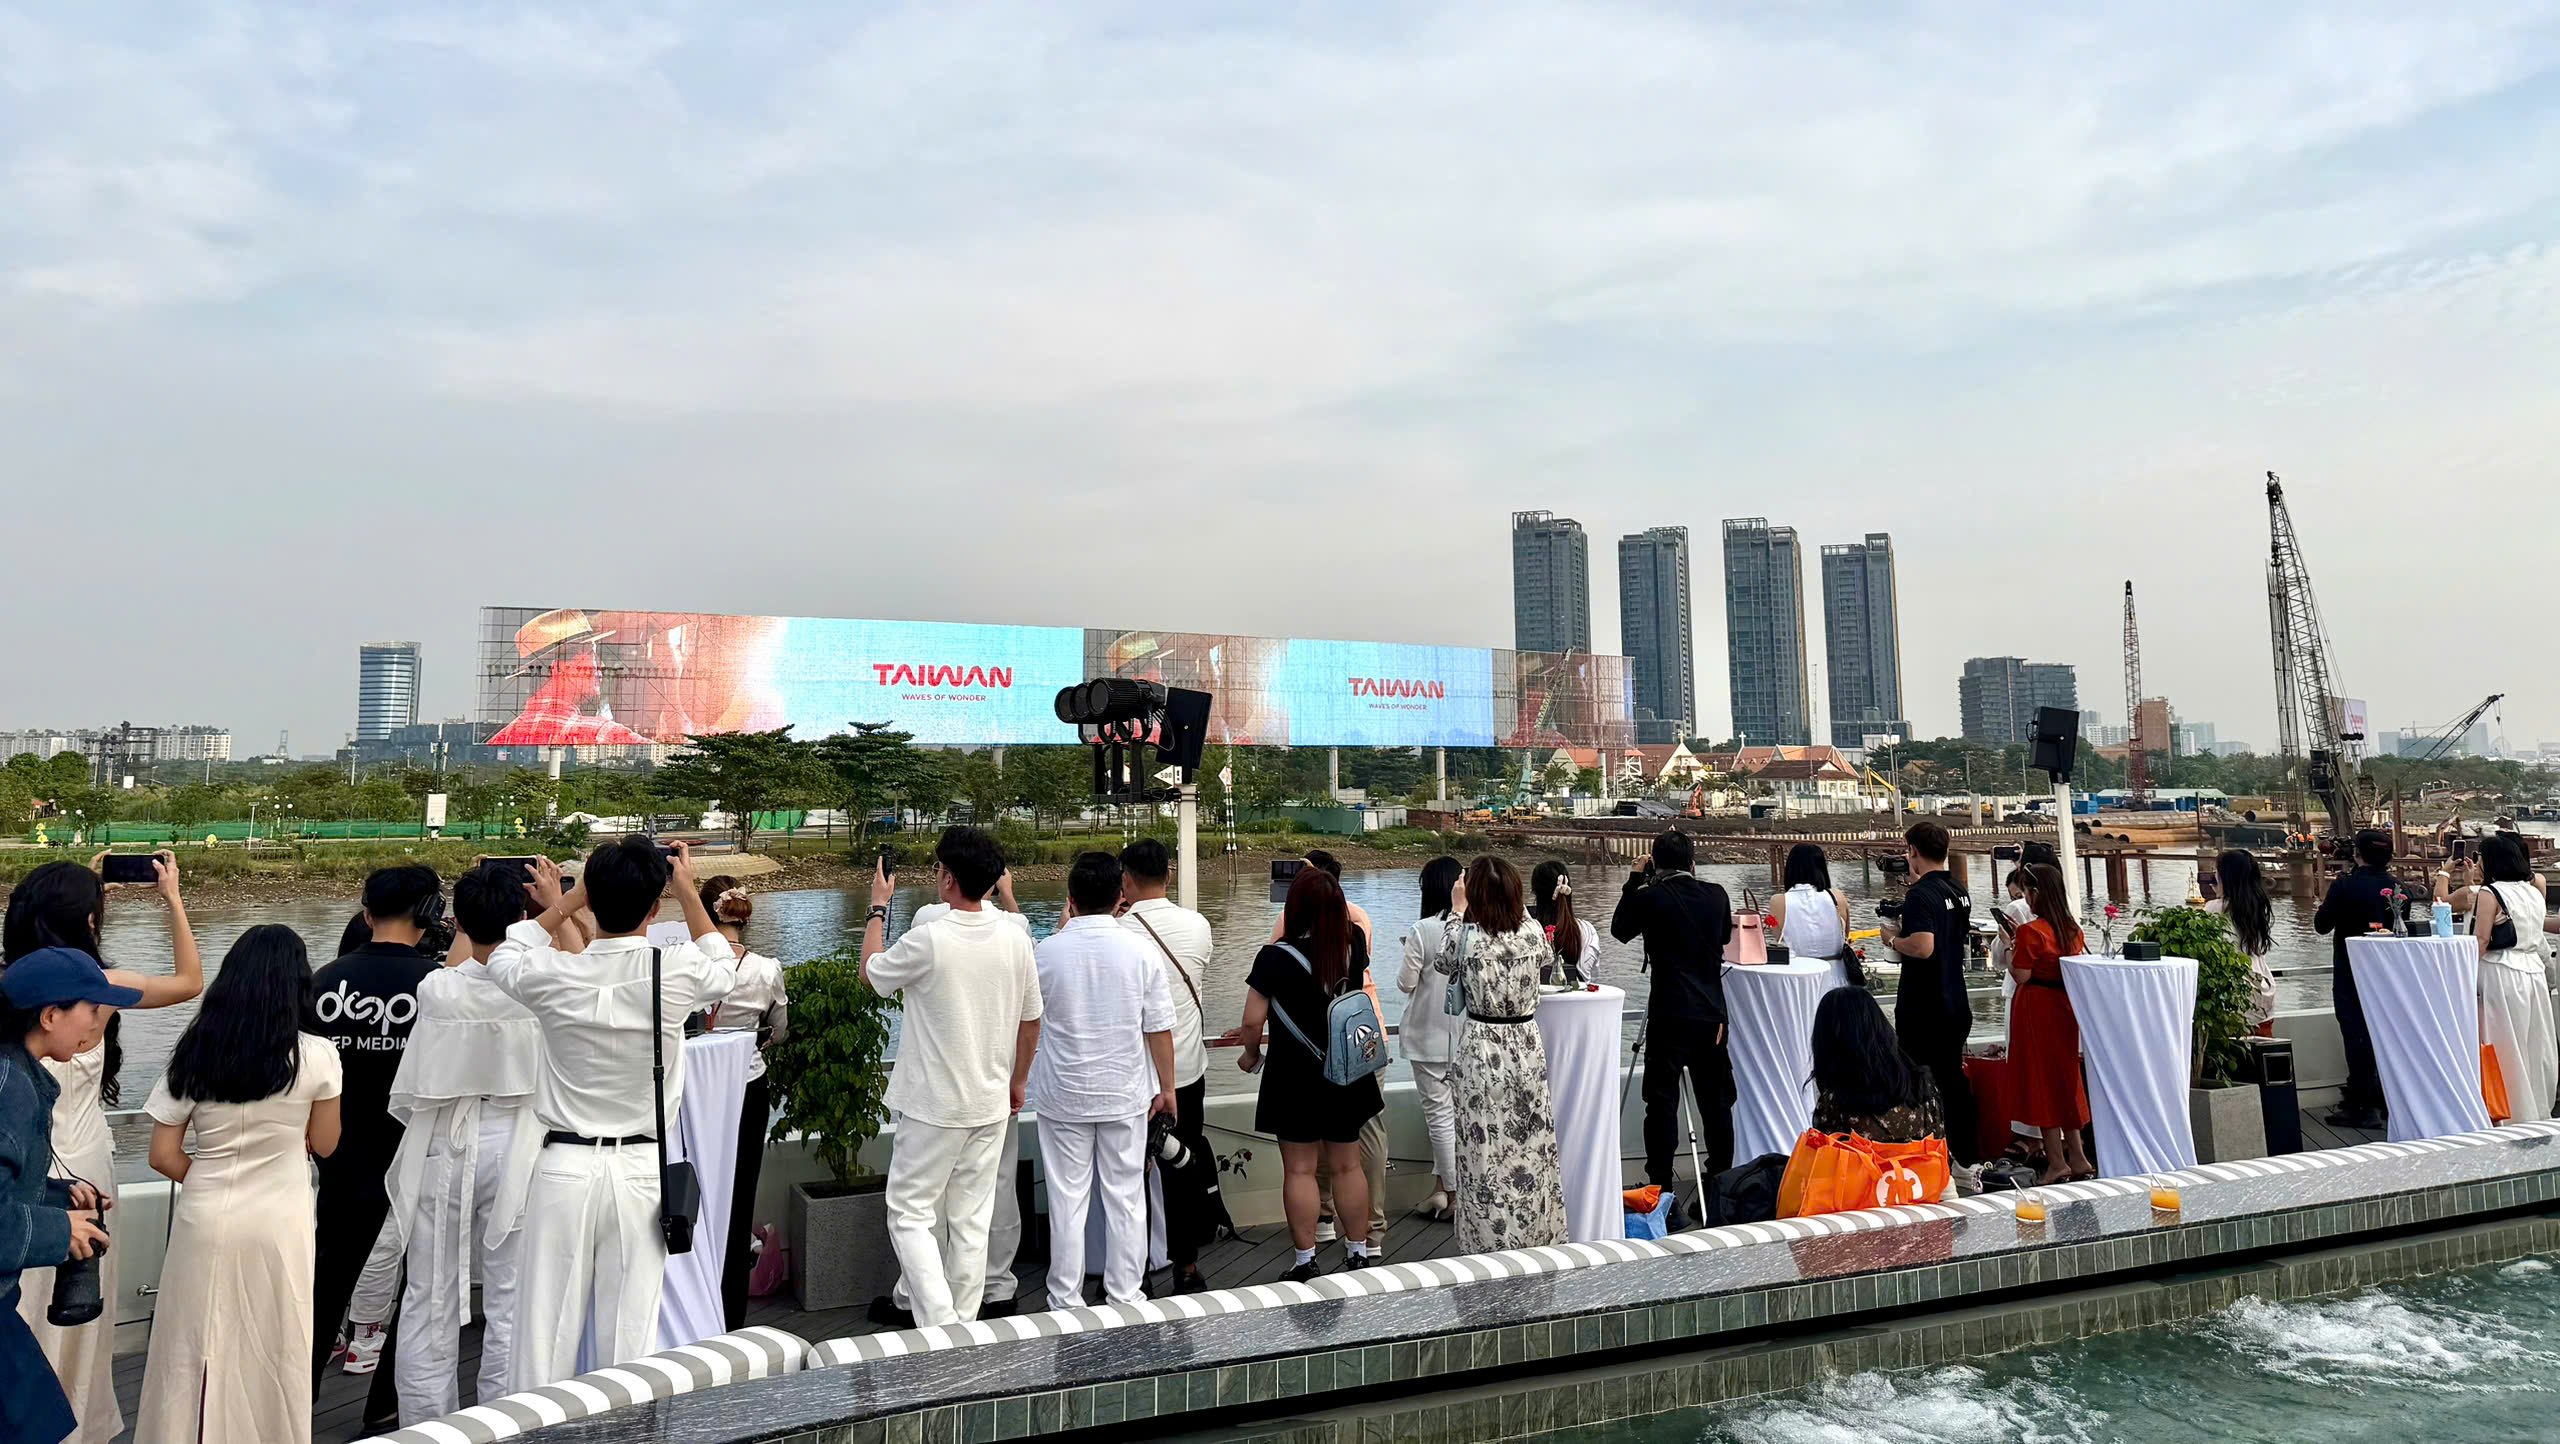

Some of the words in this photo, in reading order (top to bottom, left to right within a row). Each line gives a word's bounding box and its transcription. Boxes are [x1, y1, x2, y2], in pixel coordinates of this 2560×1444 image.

[873, 663, 1012, 688] TAIWAN
[901, 693, 932, 701] WAVES
[934, 693, 946, 701] OF
[948, 694, 987, 702] WONDER
[1348, 677, 1444, 700] TAIWAN
